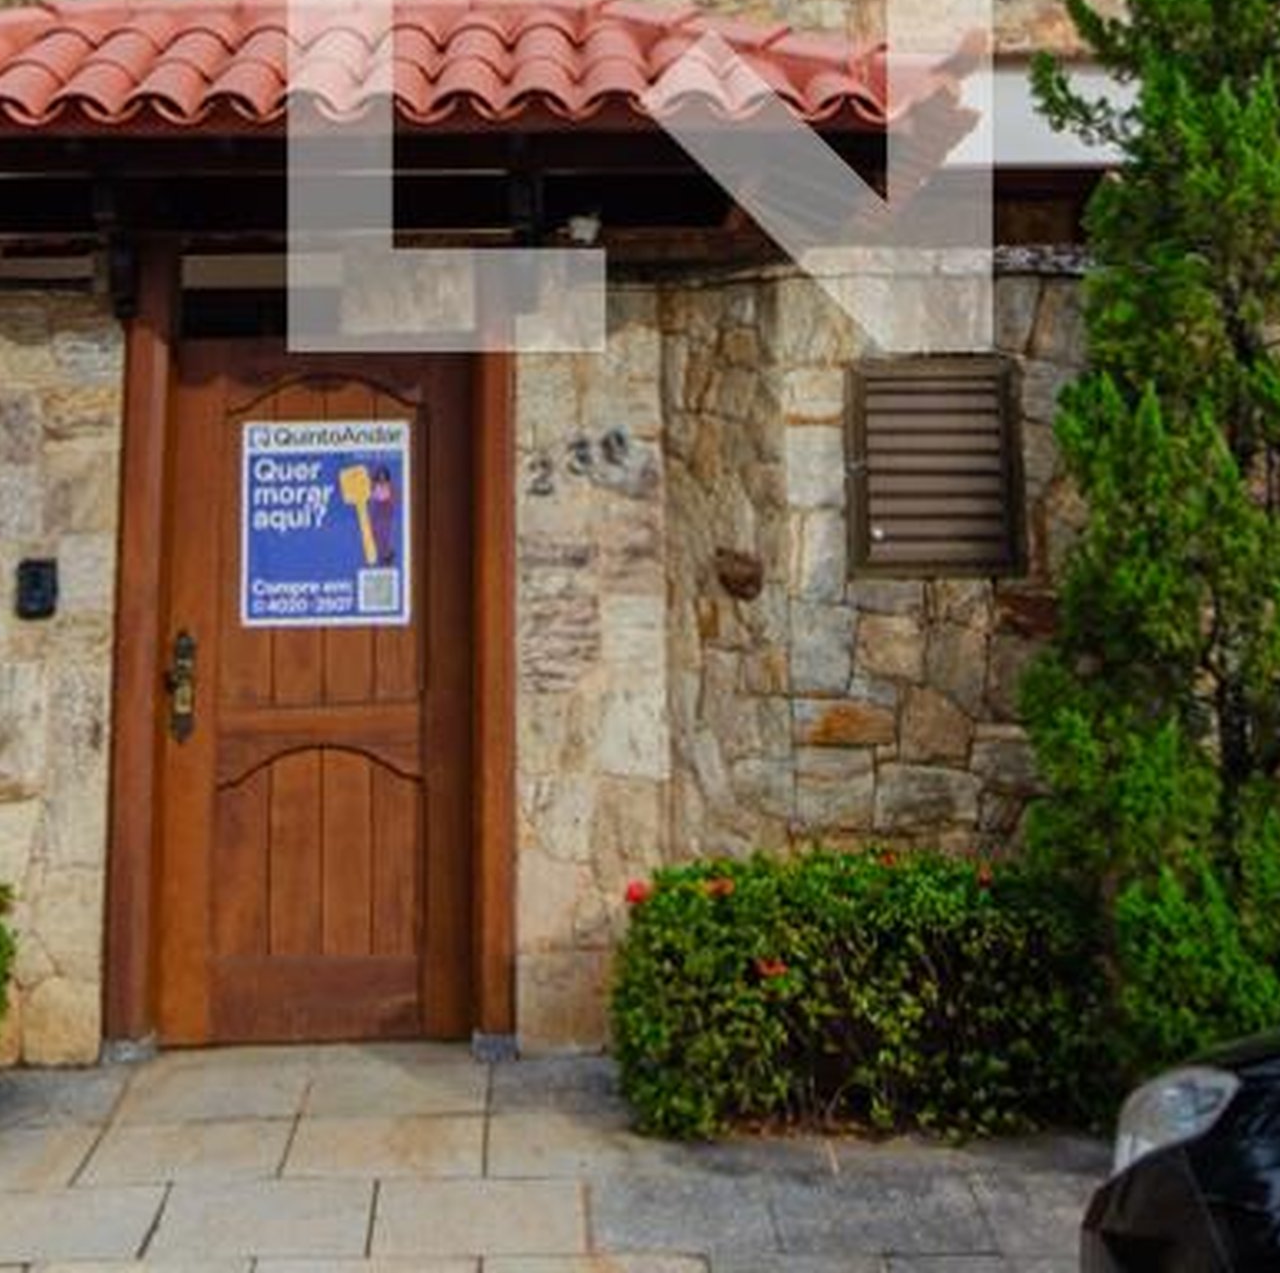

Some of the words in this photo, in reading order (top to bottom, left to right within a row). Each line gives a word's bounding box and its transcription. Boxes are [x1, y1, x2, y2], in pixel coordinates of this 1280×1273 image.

[254, 459, 322, 482] Quer
[254, 485, 334, 505] morar
[253, 505, 326, 532] aqui?
